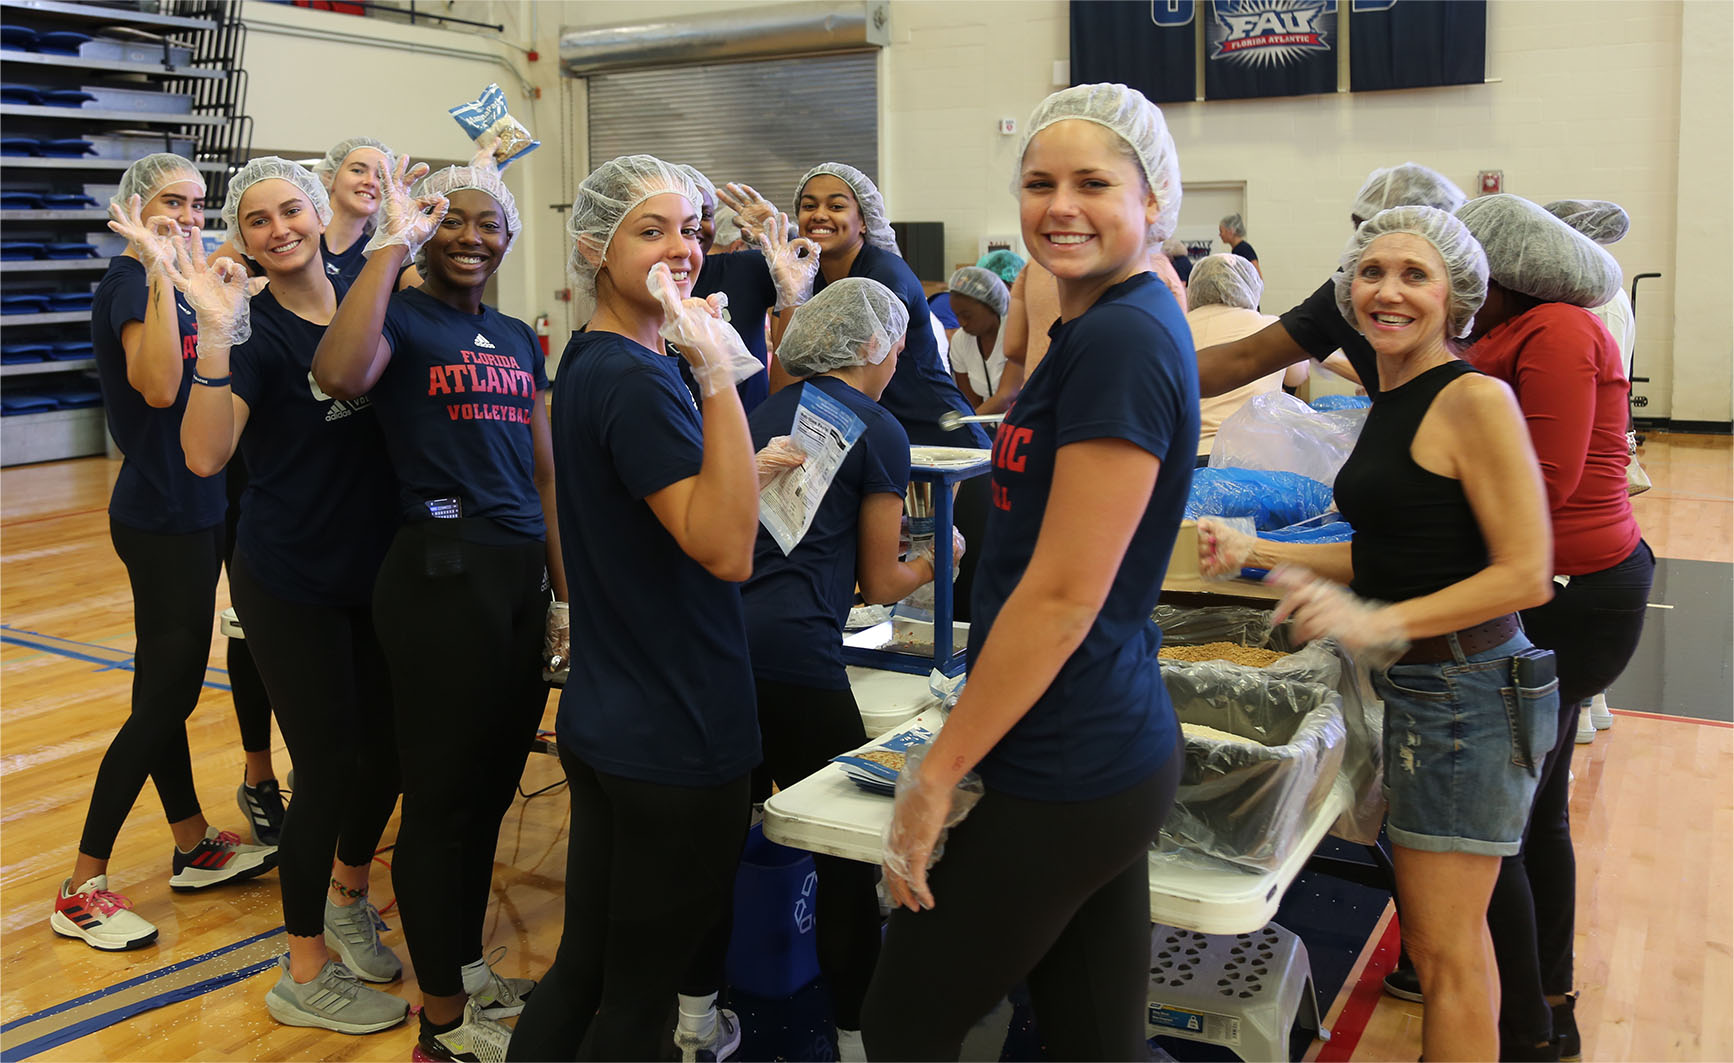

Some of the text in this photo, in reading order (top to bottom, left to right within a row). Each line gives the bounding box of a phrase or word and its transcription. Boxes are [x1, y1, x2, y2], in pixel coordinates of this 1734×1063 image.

[1223, 8, 1321, 40] FAU
[1231, 34, 1310, 49] FLORIDA ATLANTIC
[460, 350, 521, 369] FLORIDA
[325, 409, 352, 422] adidas
